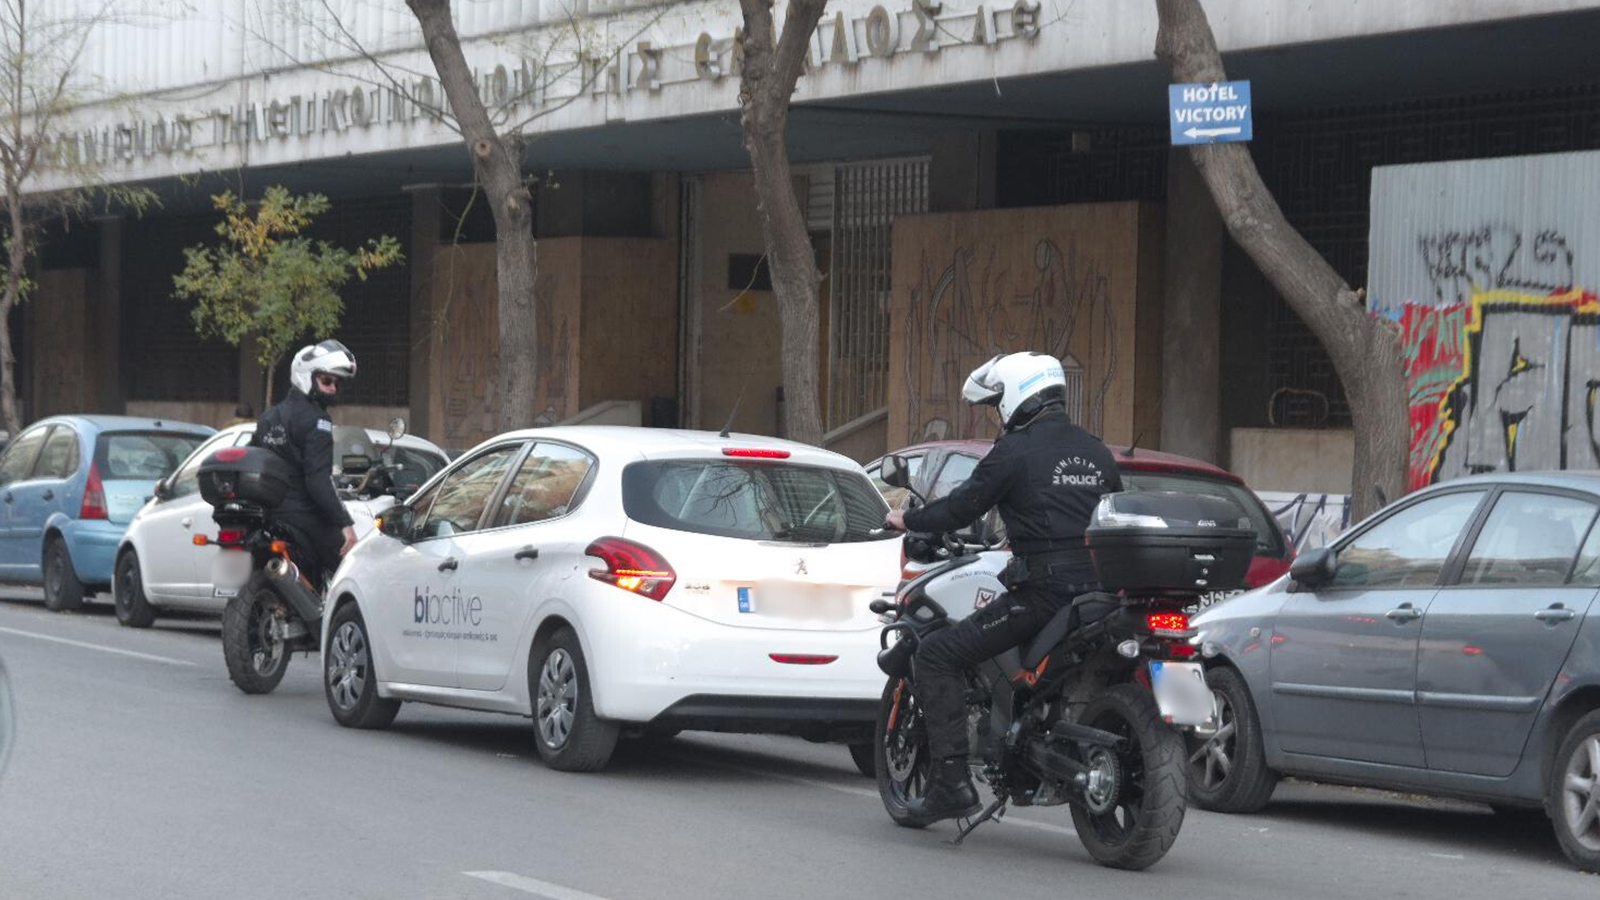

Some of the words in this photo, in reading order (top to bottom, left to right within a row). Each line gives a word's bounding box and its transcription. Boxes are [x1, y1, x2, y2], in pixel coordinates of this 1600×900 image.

[1183, 83, 1238, 102] HOTEL
[1174, 104, 1247, 123] VICTORY
[1061, 474, 1098, 485] POLICE
